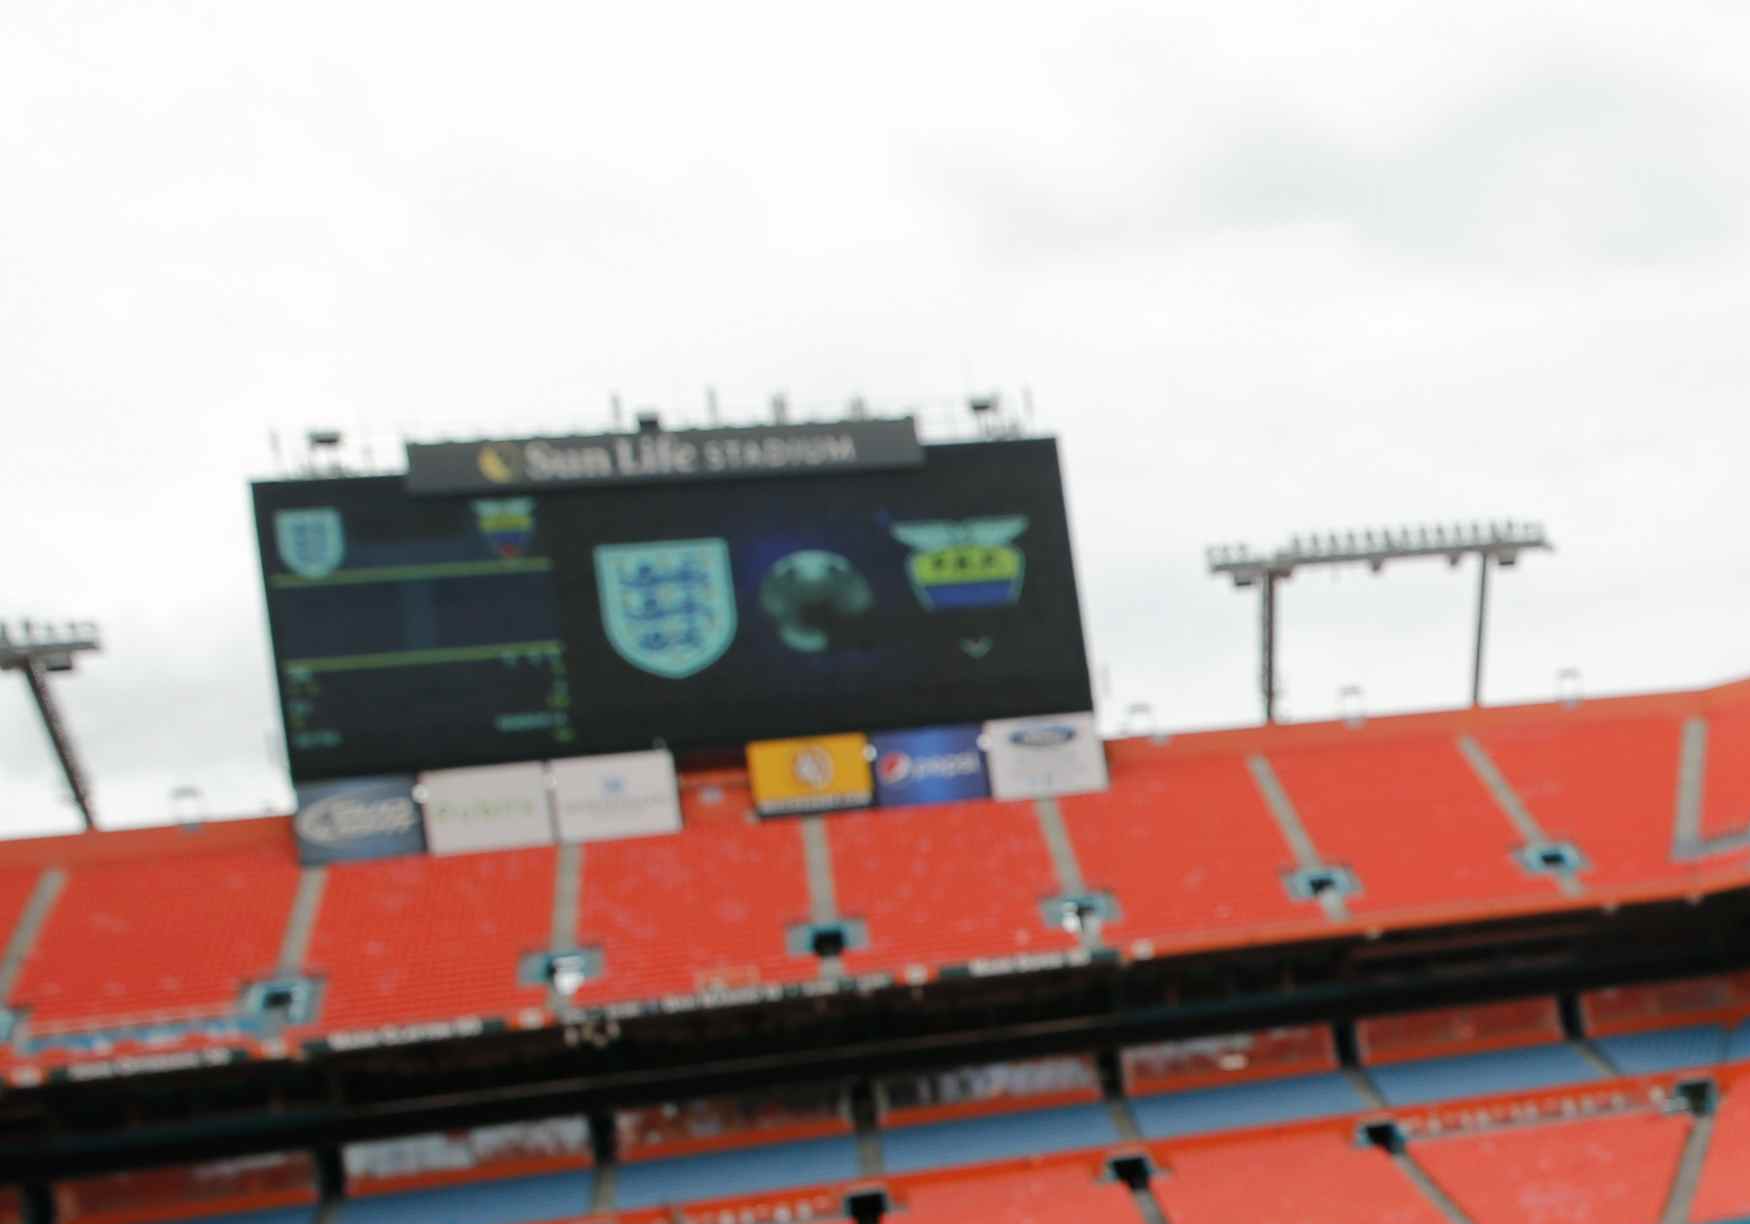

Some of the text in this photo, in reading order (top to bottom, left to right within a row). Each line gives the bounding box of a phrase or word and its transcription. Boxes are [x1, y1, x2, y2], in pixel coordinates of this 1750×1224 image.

[524, 431, 856, 482] Sun Life STADIUM
